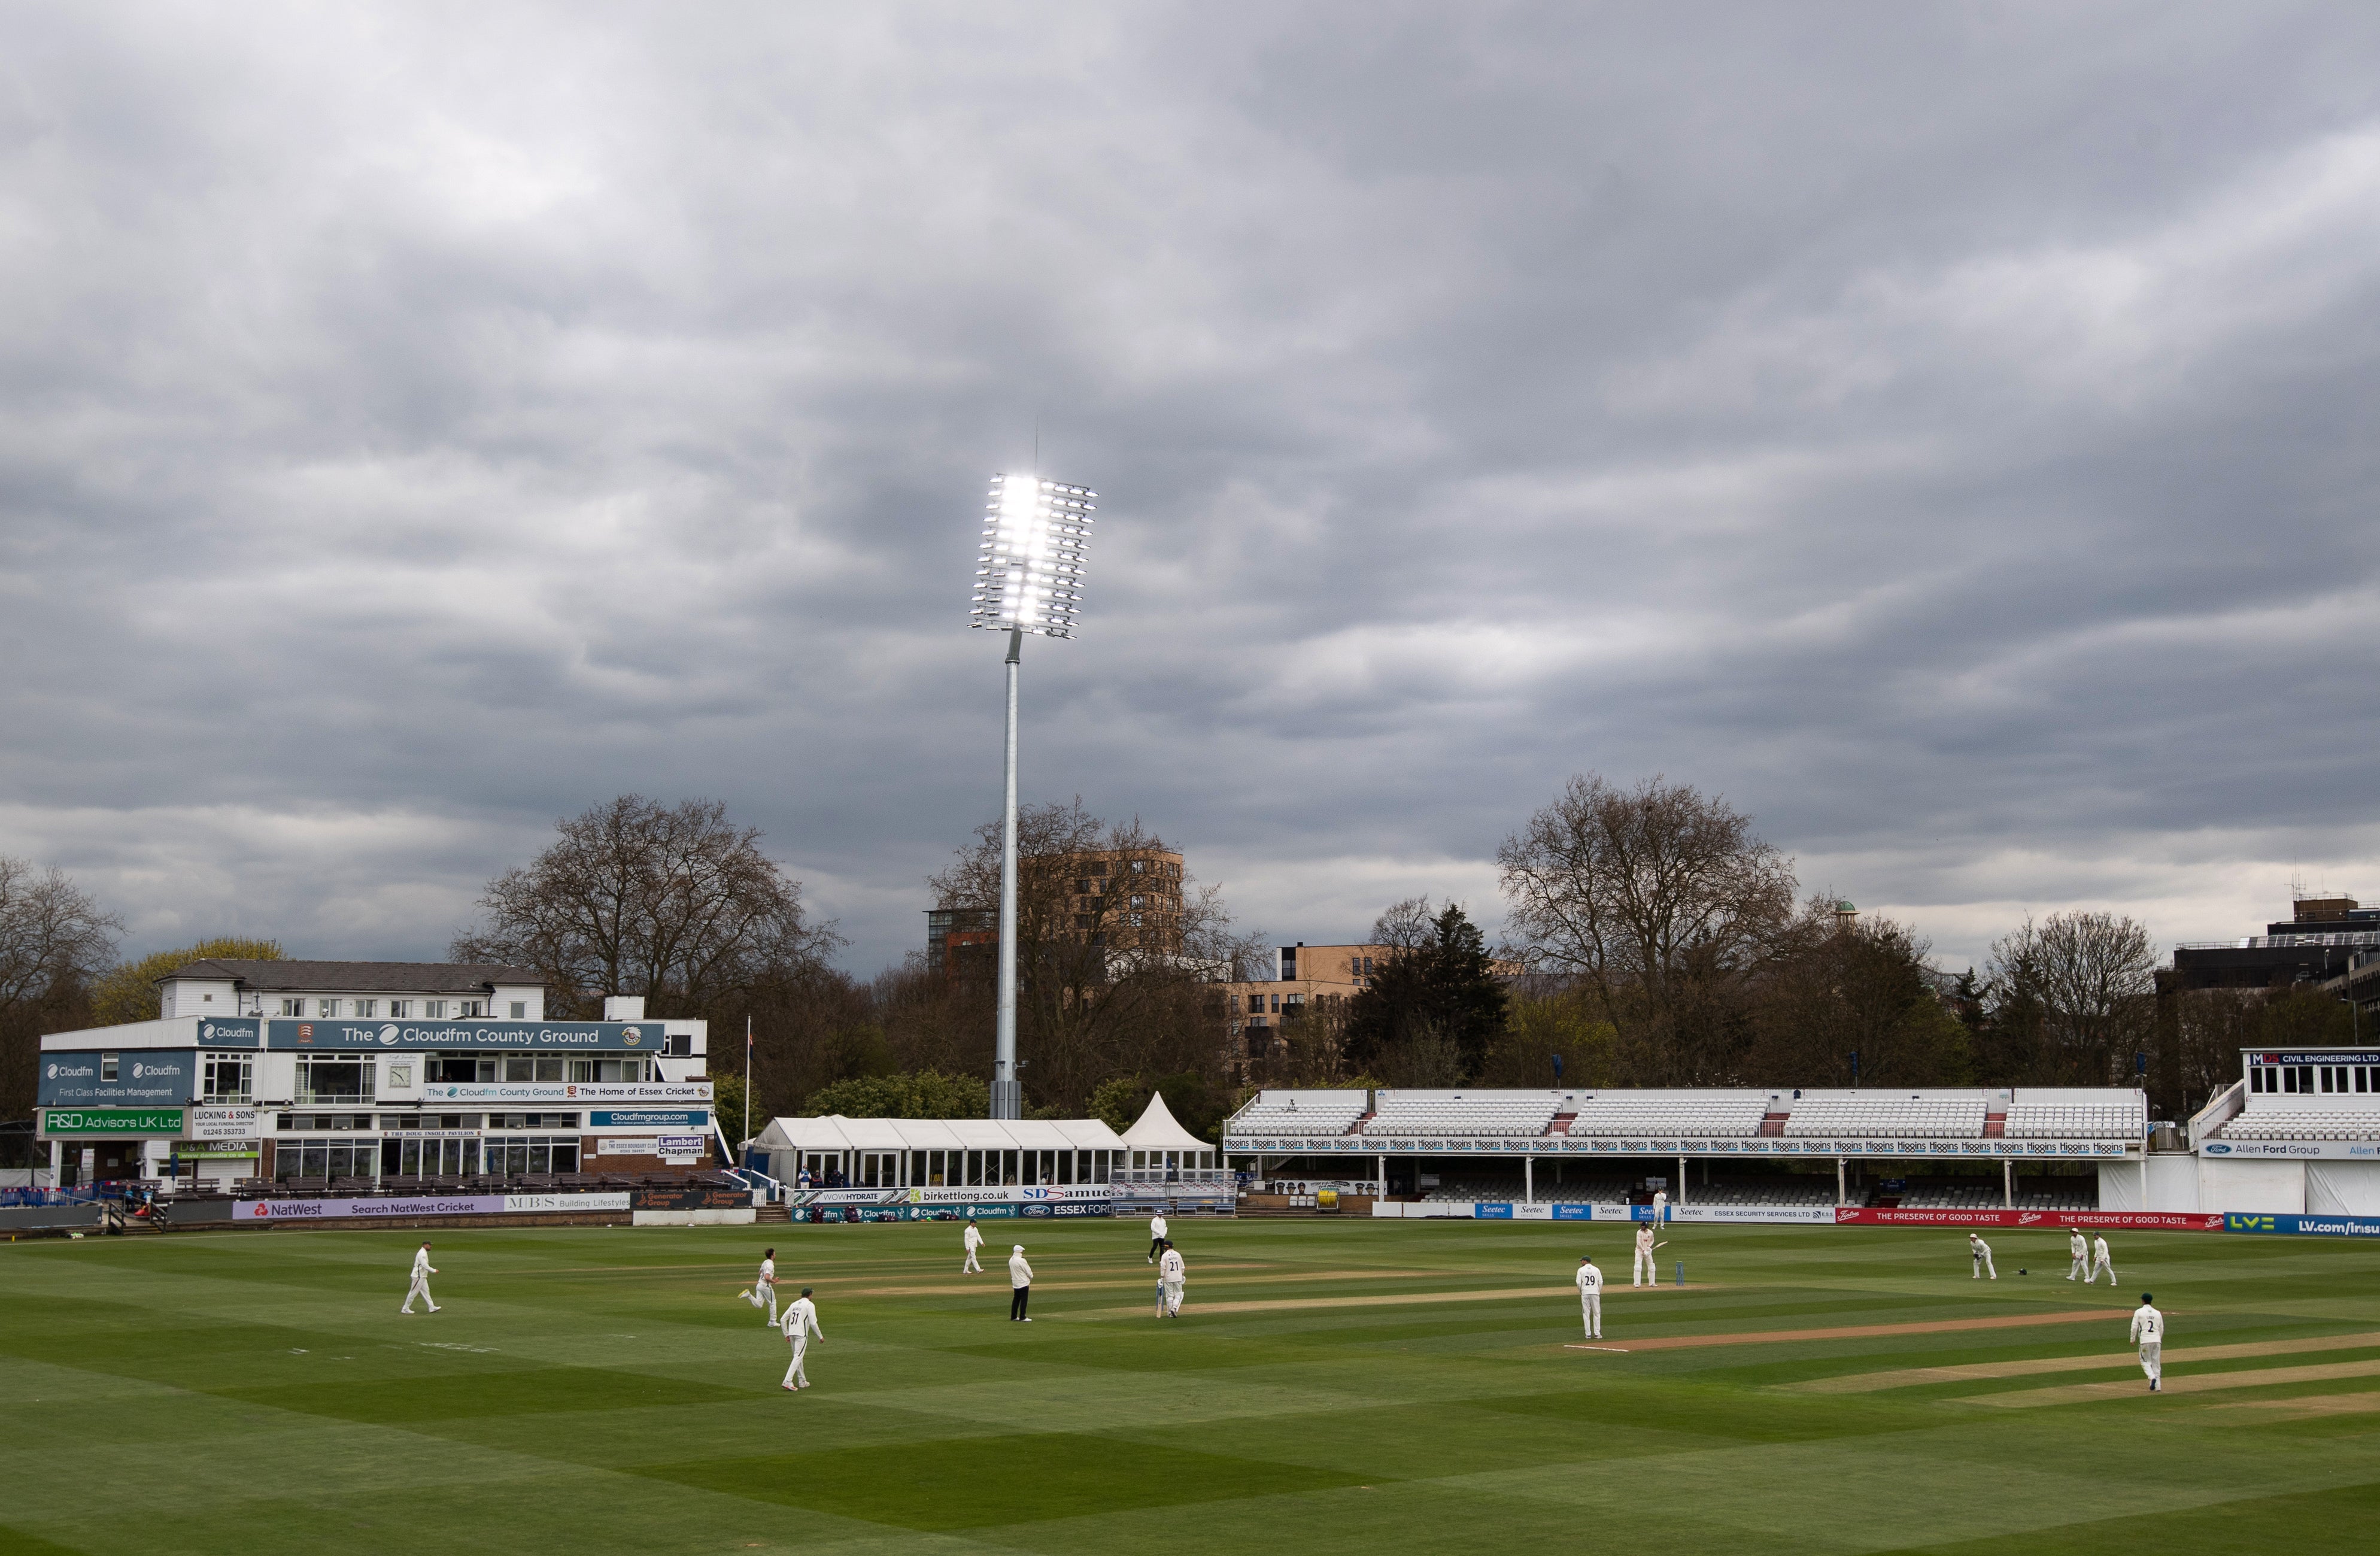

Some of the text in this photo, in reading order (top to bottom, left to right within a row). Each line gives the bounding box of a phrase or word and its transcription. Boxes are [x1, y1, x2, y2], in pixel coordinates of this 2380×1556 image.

[217, 1027, 253, 1038] Cloudfm
[342, 1027, 599, 1045] The Cloudfm County Ground
[2253, 1054, 2279, 1064] MDS
[59, 1066, 93, 1076] Cloudfm
[144, 1065, 180, 1075] Cloudfm
[95, 1088, 125, 1096] Facilities
[127, 1088, 172, 1098] Management
[500, 1088, 530, 1097] County
[48, 1114, 181, 1128] R&D Advisors UK Ltd
[195, 1111, 226, 1120] LUCKING
[611, 1113, 688, 1121] Cloudfmgroup.com
[180, 1142, 248, 1151] D&A MEDIA
[1225, 1139, 1249, 1149] Higgins
[1252, 1139, 1276, 1149] Higgins
[1279, 1139, 1304, 1149] Higgins
[1307, 1139, 1331, 1149] Higgins
[1335, 1139, 1359, 1149] Higgins
[1362, 1139, 1386, 1150] Higgins
[1391, 1139, 1415, 1150] Higgins
[1419, 1139, 1443, 1150] Higgins
[1447, 1140, 1471, 1150] Higgins
[1476, 1140, 1500, 1151] Higgins
[1504, 1140, 1529, 1151] Higgins
[1533, 1140, 1559, 1151] Higgins
[1562, 1140, 1587, 1151] Higgins
[1592, 1141, 1617, 1151] Higgins
[1621, 1141, 1647, 1151] Higgins
[1651, 1141, 1677, 1151] Higgins
[1681, 1141, 1707, 1151] Higgins
[1711, 1141, 1738, 1152] Higgins
[1742, 1141, 1768, 1152] Higgins
[1772, 1141, 1799, 1152] Higgins
[1804, 1141, 1830, 1152] Higgins
[1835, 1141, 1862, 1152] Higgins
[1866, 1141, 1894, 1152] Higgins
[1898, 1142, 1926, 1152] Higgins
[1930, 1142, 1959, 1153] Higgins
[1962, 1142, 1991, 1153] Higgins
[1995, 1142, 2023, 1153] Higgins
[2027, 1142, 2057, 1153] Higgins
[2060, 1142, 2089, 1154] Higgins
[2094, 1142, 2123, 1154] Higgins
[658, 1147, 703, 1155] Chapman
[2236, 1145, 2320, 1155] Allen Ford Group
[924, 1191, 1009, 1201] birkettlong.co.uk
[271, 1203, 322, 1215] NatWest
[351, 1202, 475, 1214] Search NatWest Cricket
[560, 1199, 630, 1209] Building Lifestyles
[1054, 1205, 1086, 1215] ESSEX
[1170, 1261, 1179, 1271] 21
[1585, 1275, 1595, 1286] 29
[791, 1312, 800, 1325] 31
[2148, 1320, 2154, 1333] 2
